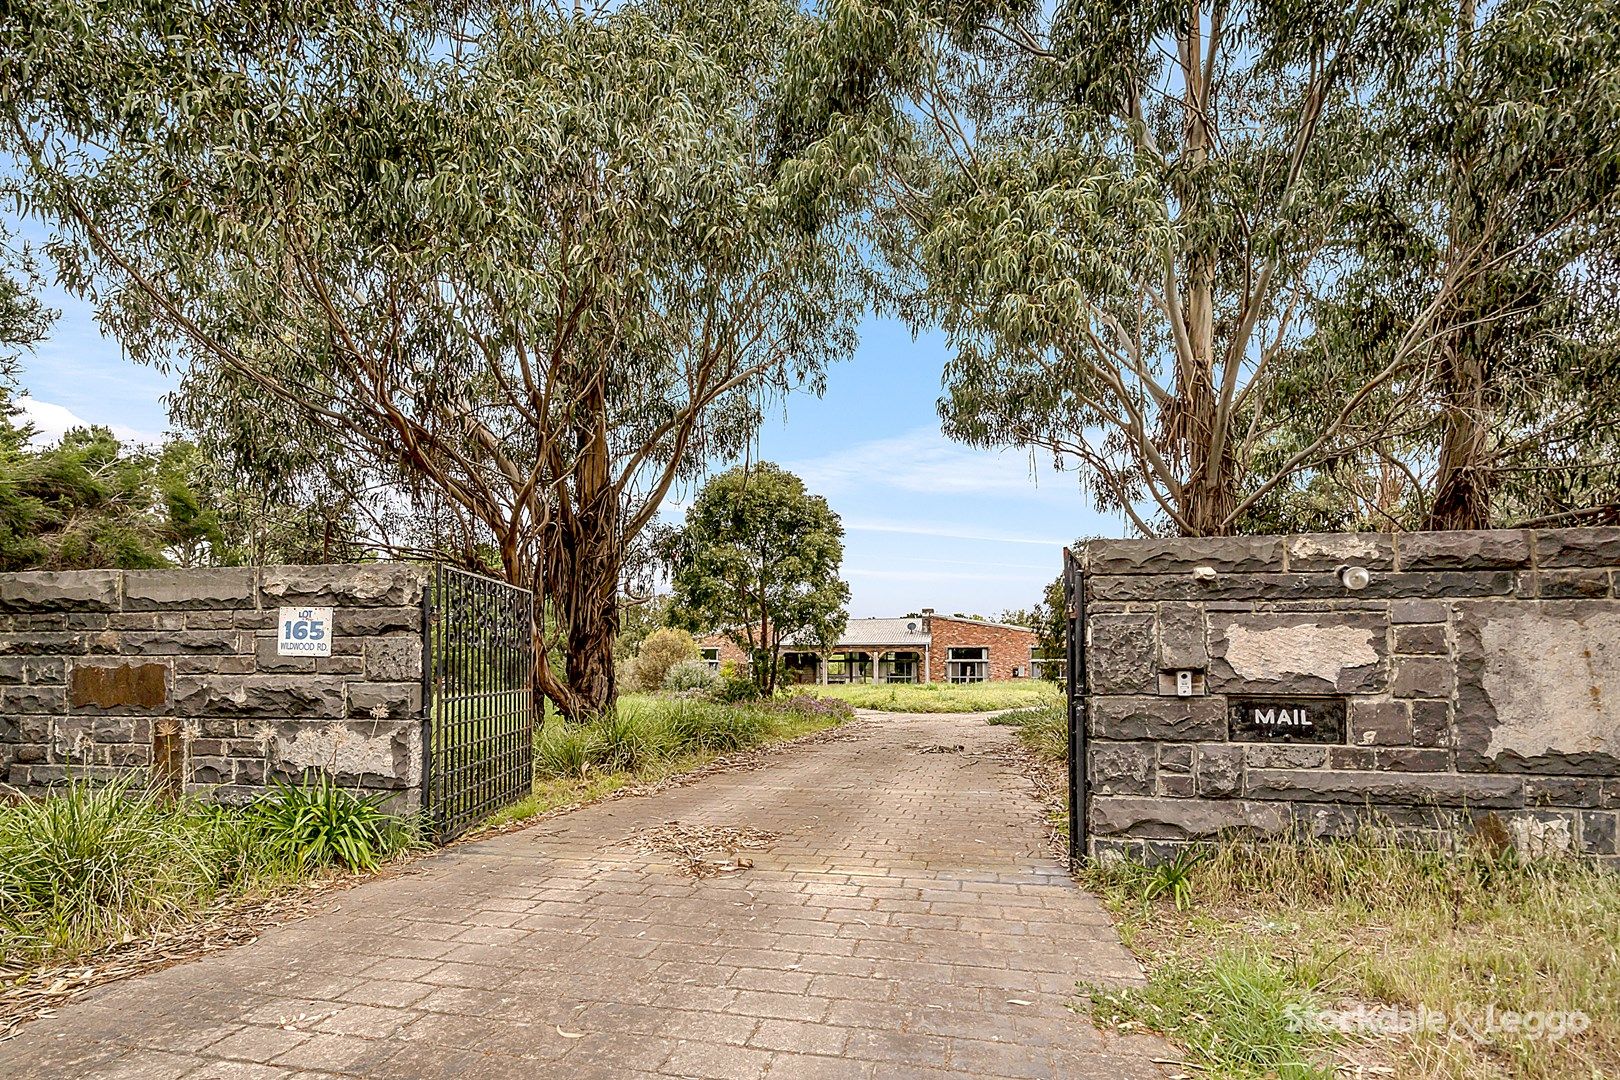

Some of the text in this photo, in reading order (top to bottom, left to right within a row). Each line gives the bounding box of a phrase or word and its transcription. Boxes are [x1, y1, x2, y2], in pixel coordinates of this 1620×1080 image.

[298, 610, 313, 618] LOT
[284, 620, 325, 640] 165
[280, 642, 315, 651] WILDWOOD
[1254, 708, 1313, 726] MAIL
